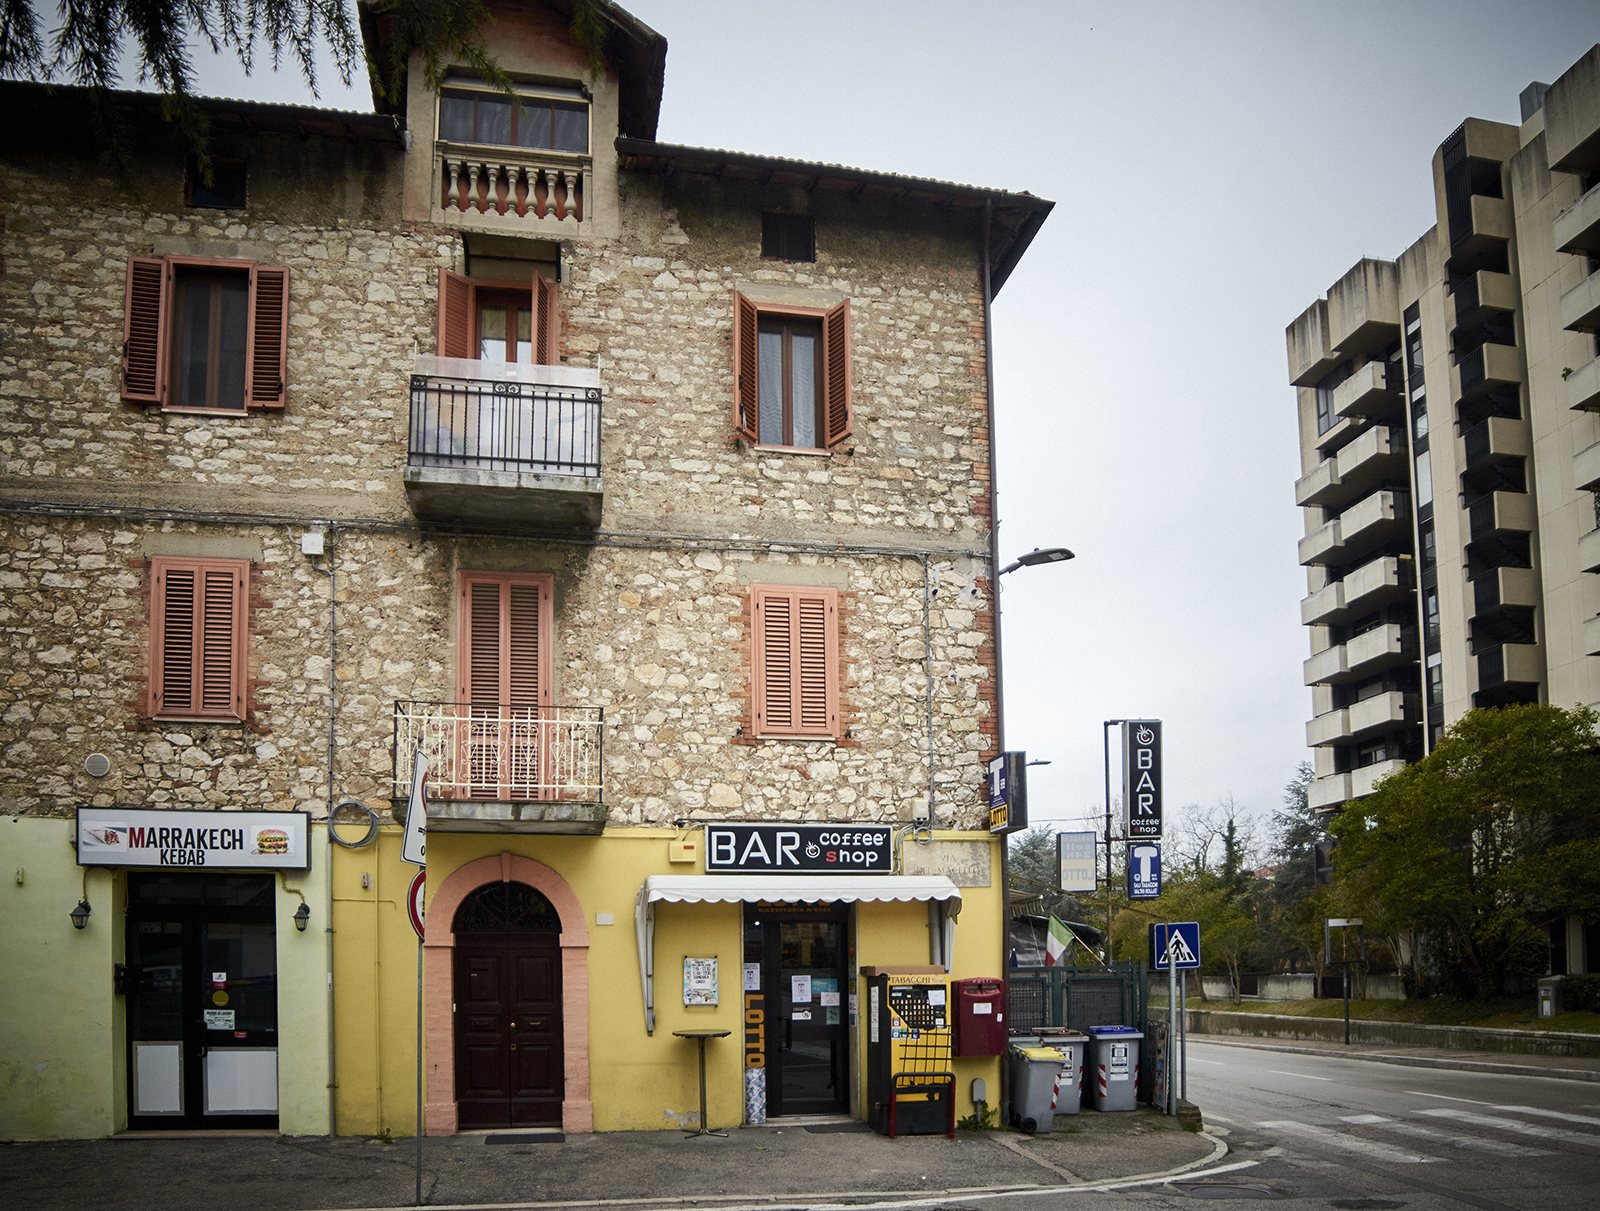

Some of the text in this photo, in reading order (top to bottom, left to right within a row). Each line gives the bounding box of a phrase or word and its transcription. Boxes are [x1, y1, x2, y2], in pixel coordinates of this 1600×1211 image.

[1136, 748, 1155, 815] BAR
[990, 806, 1007, 827] LOTTO
[128, 827, 244, 850] MARRAKECH
[711, 831, 800, 866] BAR
[160, 849, 205, 866] KEBAB
[825, 850, 878, 867] shop
[940, 854, 957, 862] VIA
[891, 976, 931, 984] TABACCHI
[745, 994, 765, 1067] LOTTO
